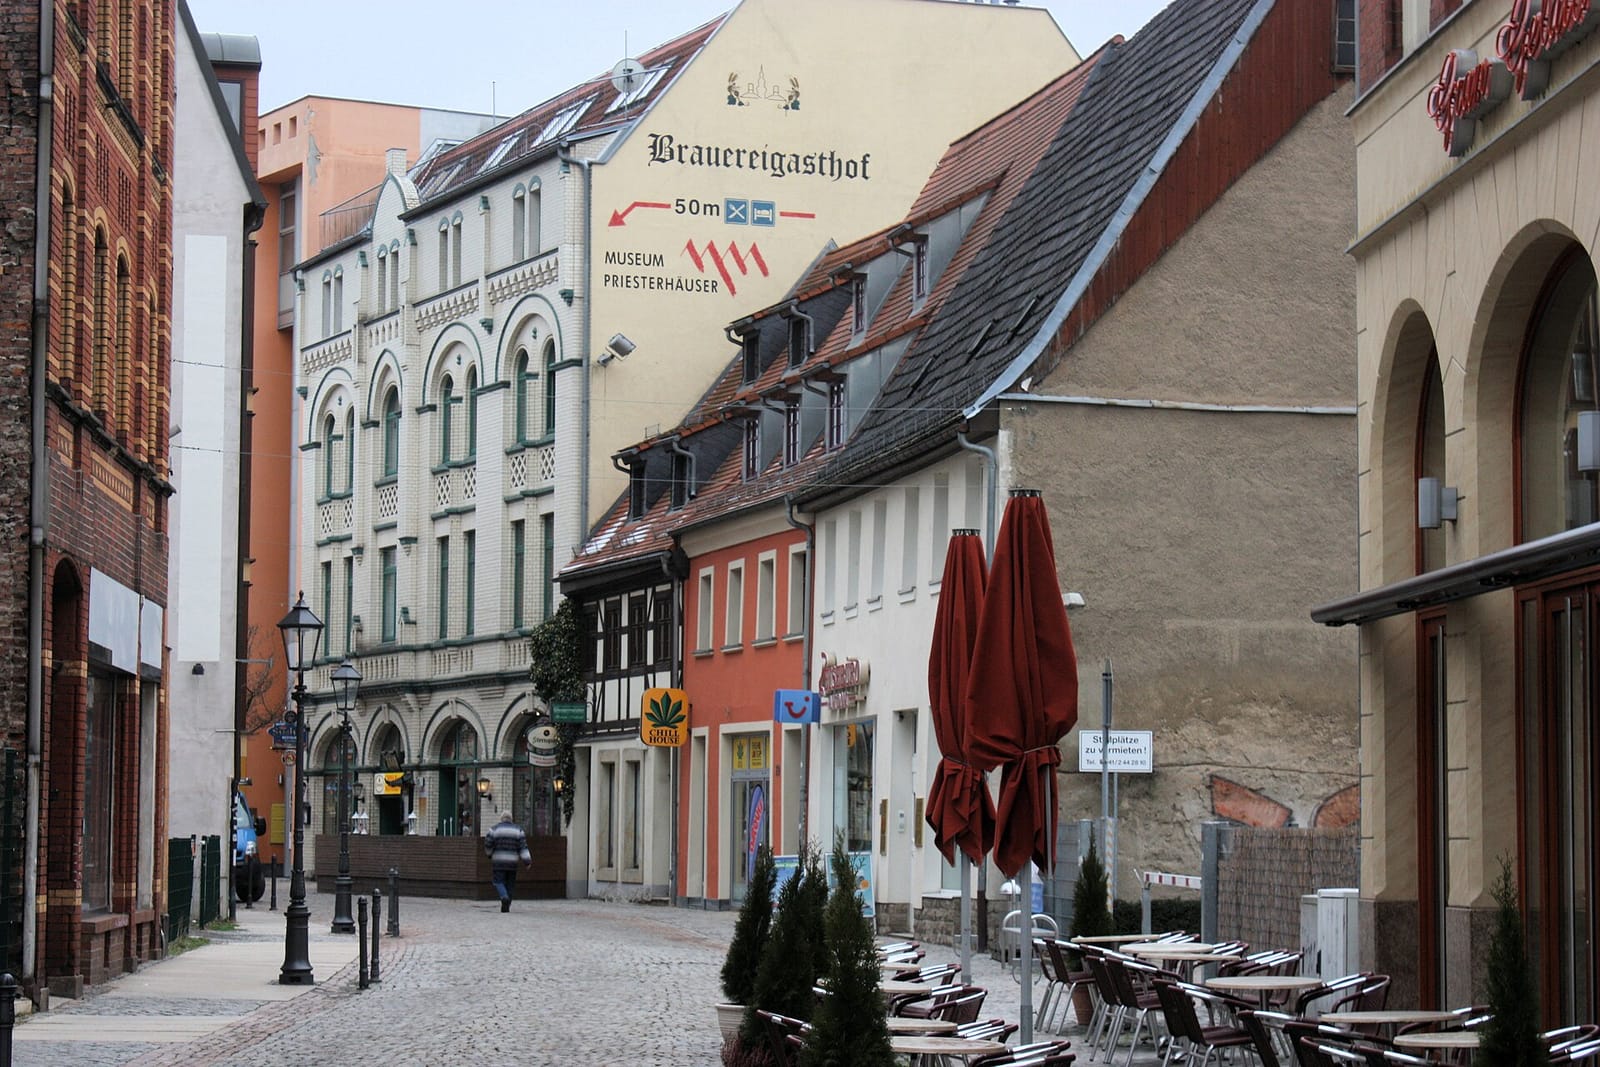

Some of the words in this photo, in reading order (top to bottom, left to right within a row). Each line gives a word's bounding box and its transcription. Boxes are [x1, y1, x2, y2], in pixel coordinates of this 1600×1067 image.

[648, 133, 870, 182] Brauereigasthof
[604, 251, 664, 268] MUSEUM
[603, 273, 719, 294] PRIESTERHÄUSER
[649, 728, 680, 737] CHILL
[649, 736, 680, 745] HOUSE
[1092, 735, 1139, 744] Stlplätze
[1098, 746, 1147, 754] vrmieten!
